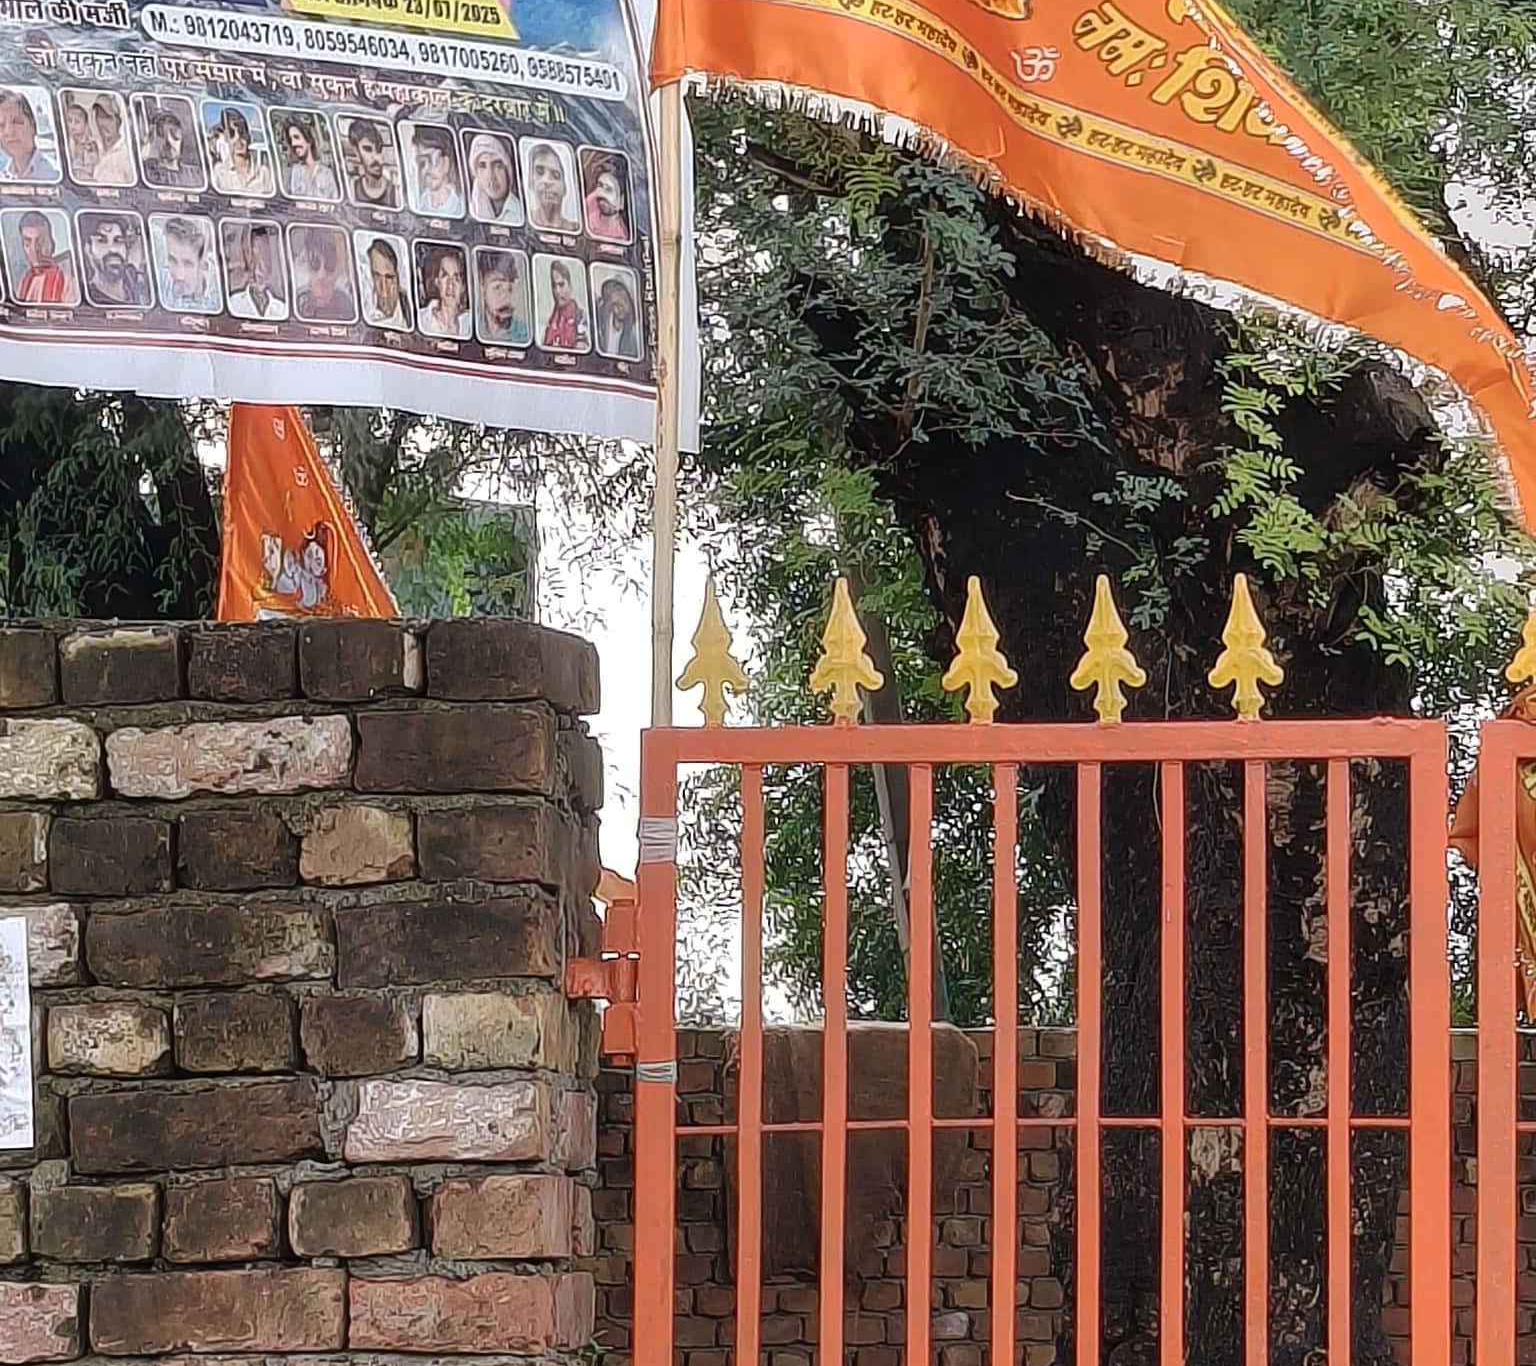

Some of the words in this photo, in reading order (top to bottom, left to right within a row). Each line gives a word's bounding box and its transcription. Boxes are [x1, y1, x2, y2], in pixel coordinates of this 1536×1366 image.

[915, 18, 959, 55] महादेव
[1133, 139, 1188, 173] महादेव
[1218, 172, 1265, 203] हर-हर
[1264, 186, 1313, 221] महादेव
